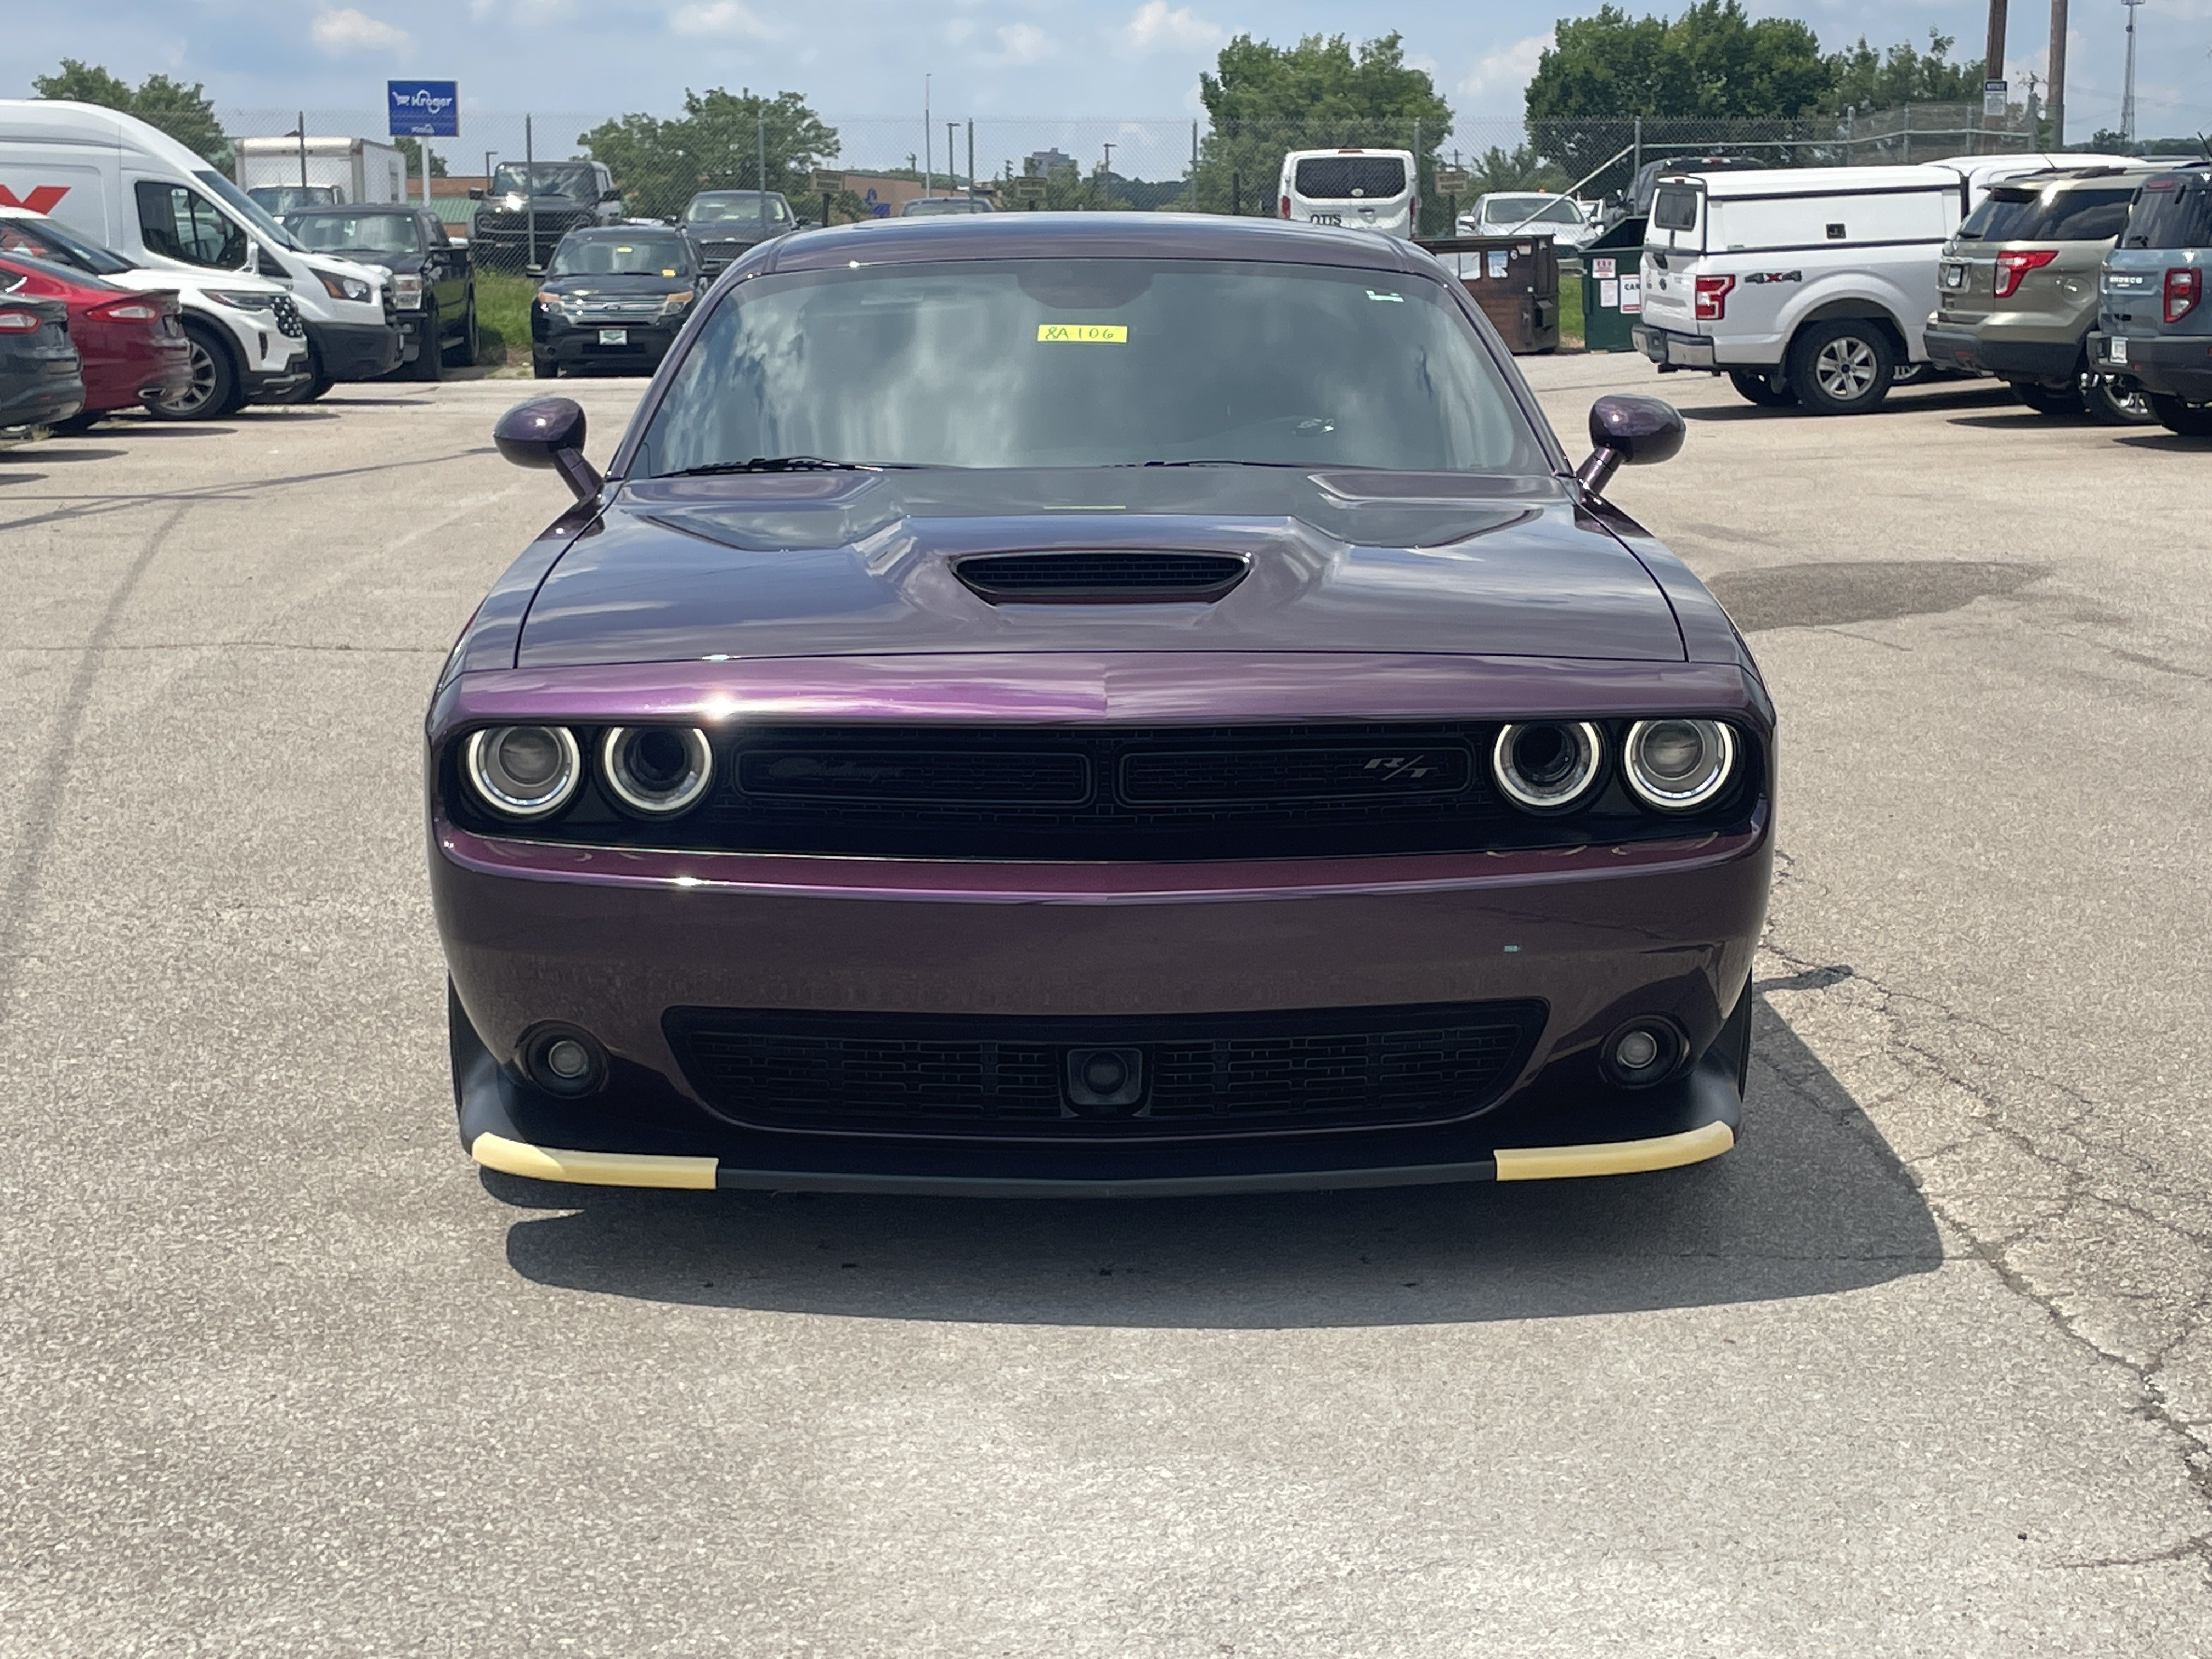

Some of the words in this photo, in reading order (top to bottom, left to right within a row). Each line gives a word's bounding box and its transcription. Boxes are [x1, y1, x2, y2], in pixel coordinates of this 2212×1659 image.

[411, 89, 453, 114] Kroger
[1310, 213, 1342, 227] OTIS
[1364, 755, 1438, 781] R/T
